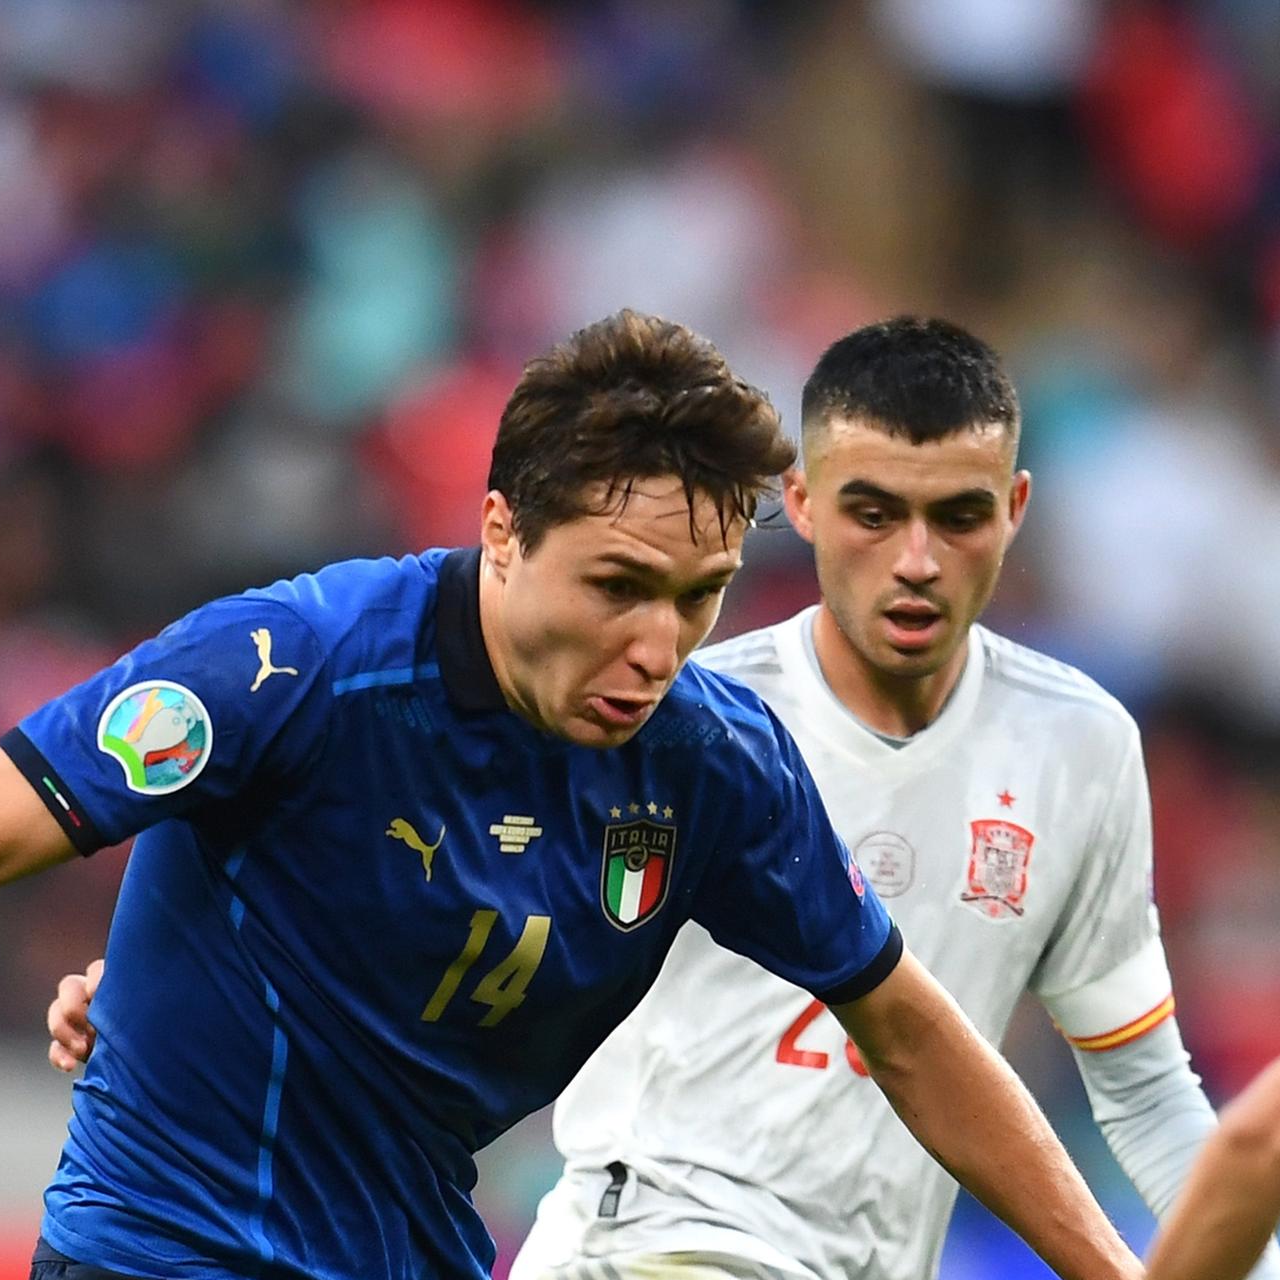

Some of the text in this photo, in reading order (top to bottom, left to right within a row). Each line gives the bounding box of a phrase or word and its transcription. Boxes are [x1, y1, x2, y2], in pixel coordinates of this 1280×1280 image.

[611, 829, 669, 849] ITALIA
[421, 909, 552, 1027] 14
[775, 998, 871, 1078] 2
